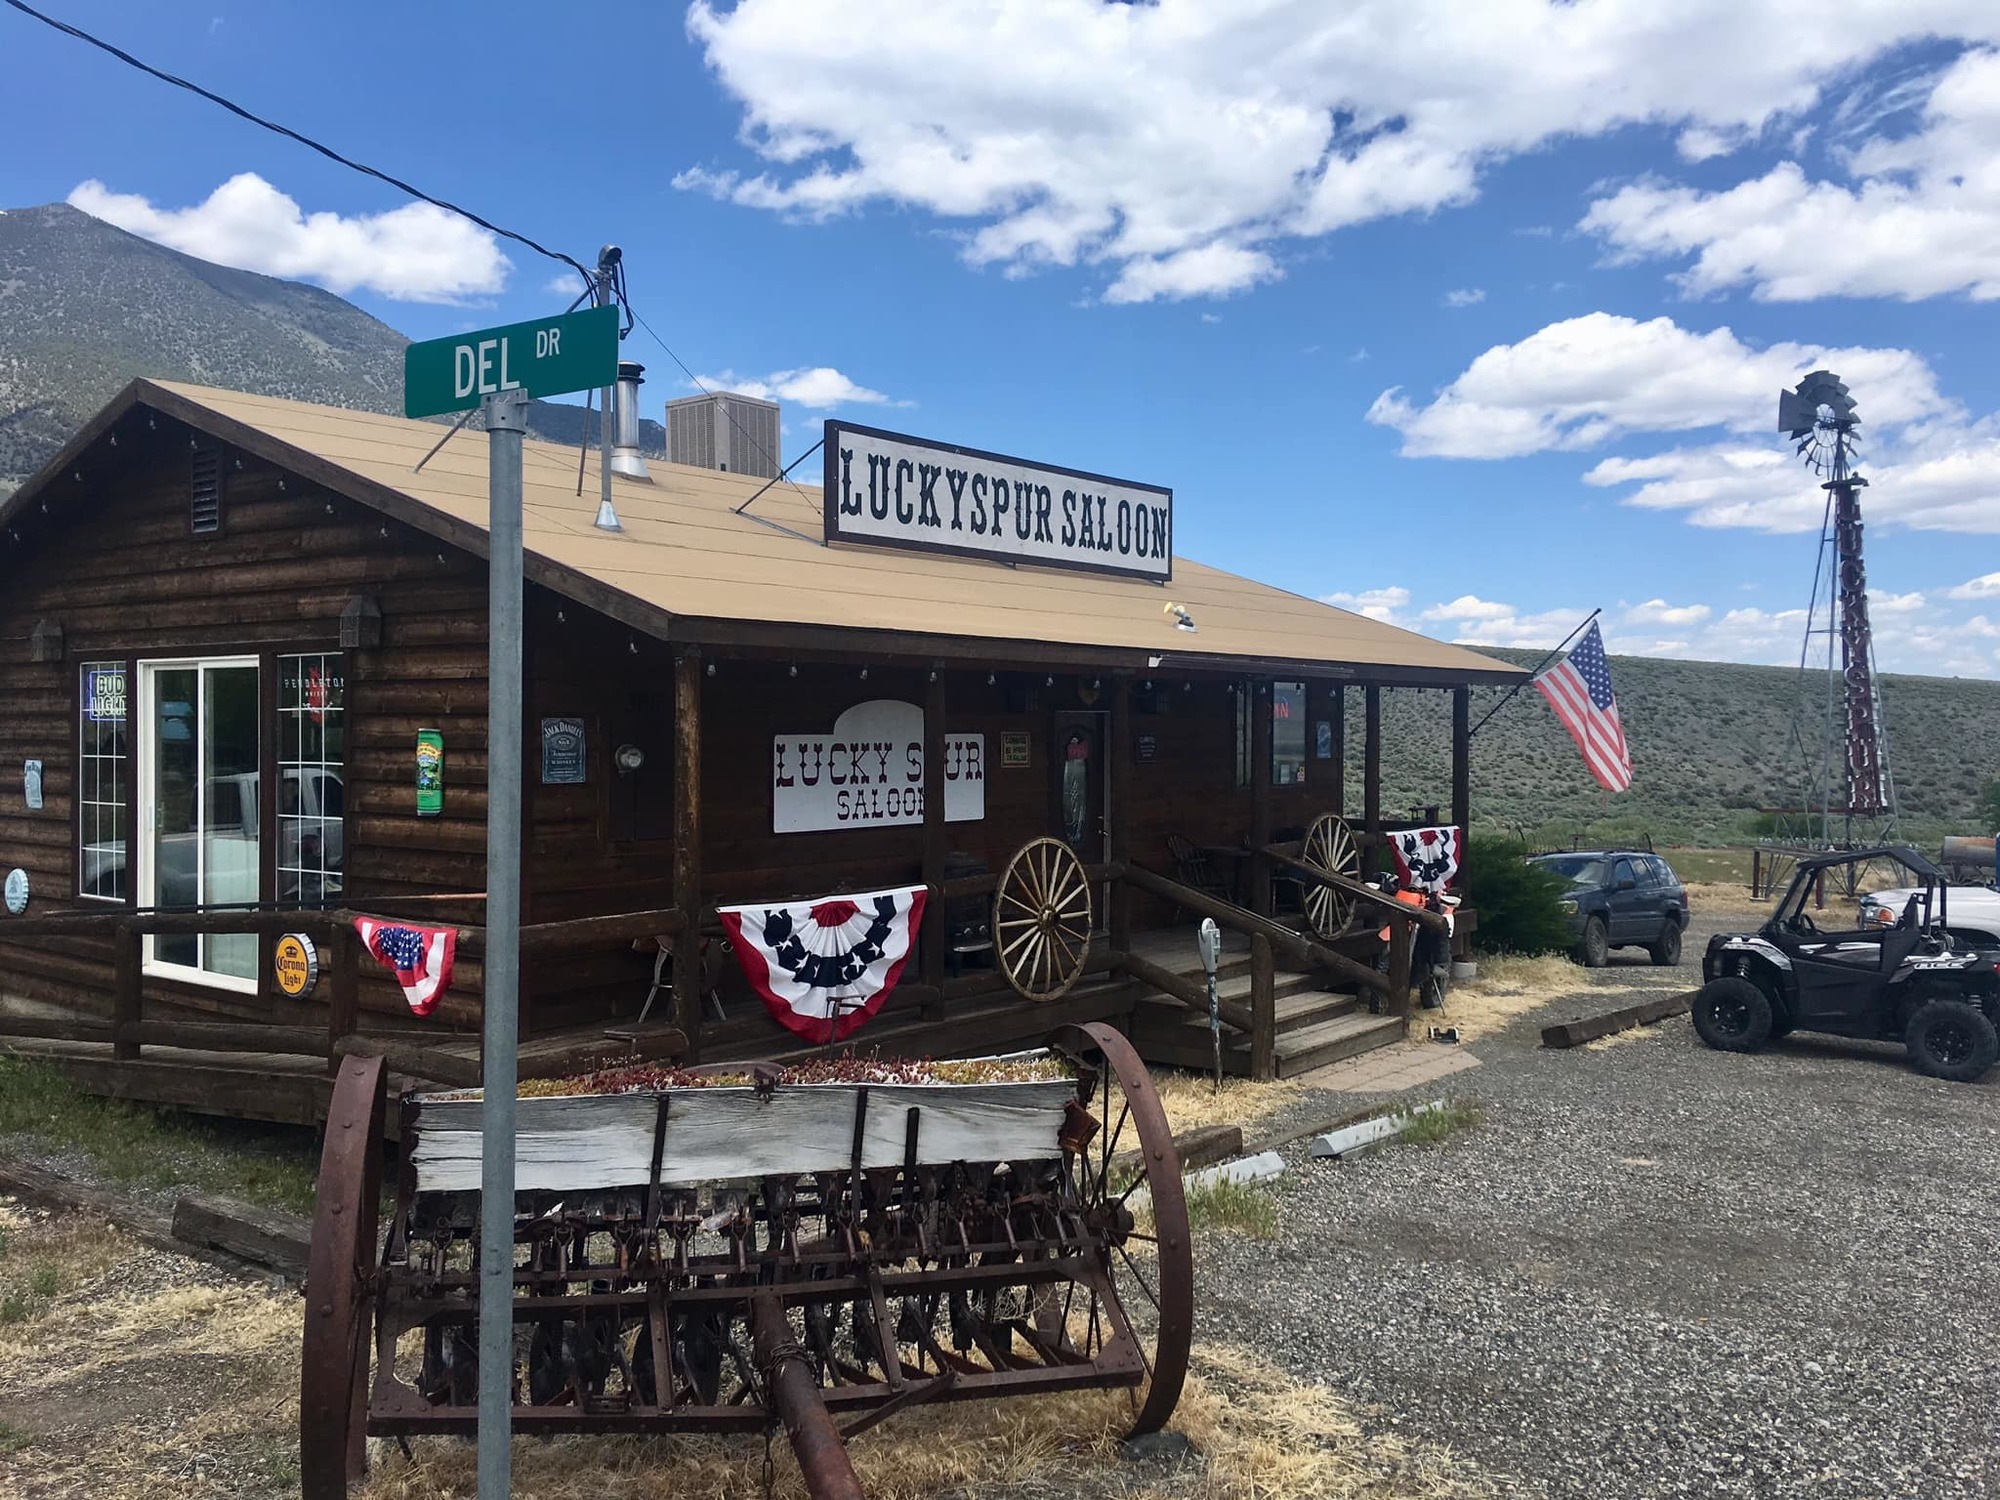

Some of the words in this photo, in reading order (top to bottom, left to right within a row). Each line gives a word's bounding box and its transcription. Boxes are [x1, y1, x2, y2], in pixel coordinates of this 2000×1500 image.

[455, 337, 520, 398] DEL
[536, 328, 561, 359] DR
[1061, 488, 1168, 560] SALOON
[97, 675, 124, 695] BUD
[544, 724, 559, 738] JACK
[776, 742, 893, 787] LUCKY
[906, 741, 983, 783] SUR
[276, 954, 306, 973] Corona
[283, 971, 302, 987] Light
